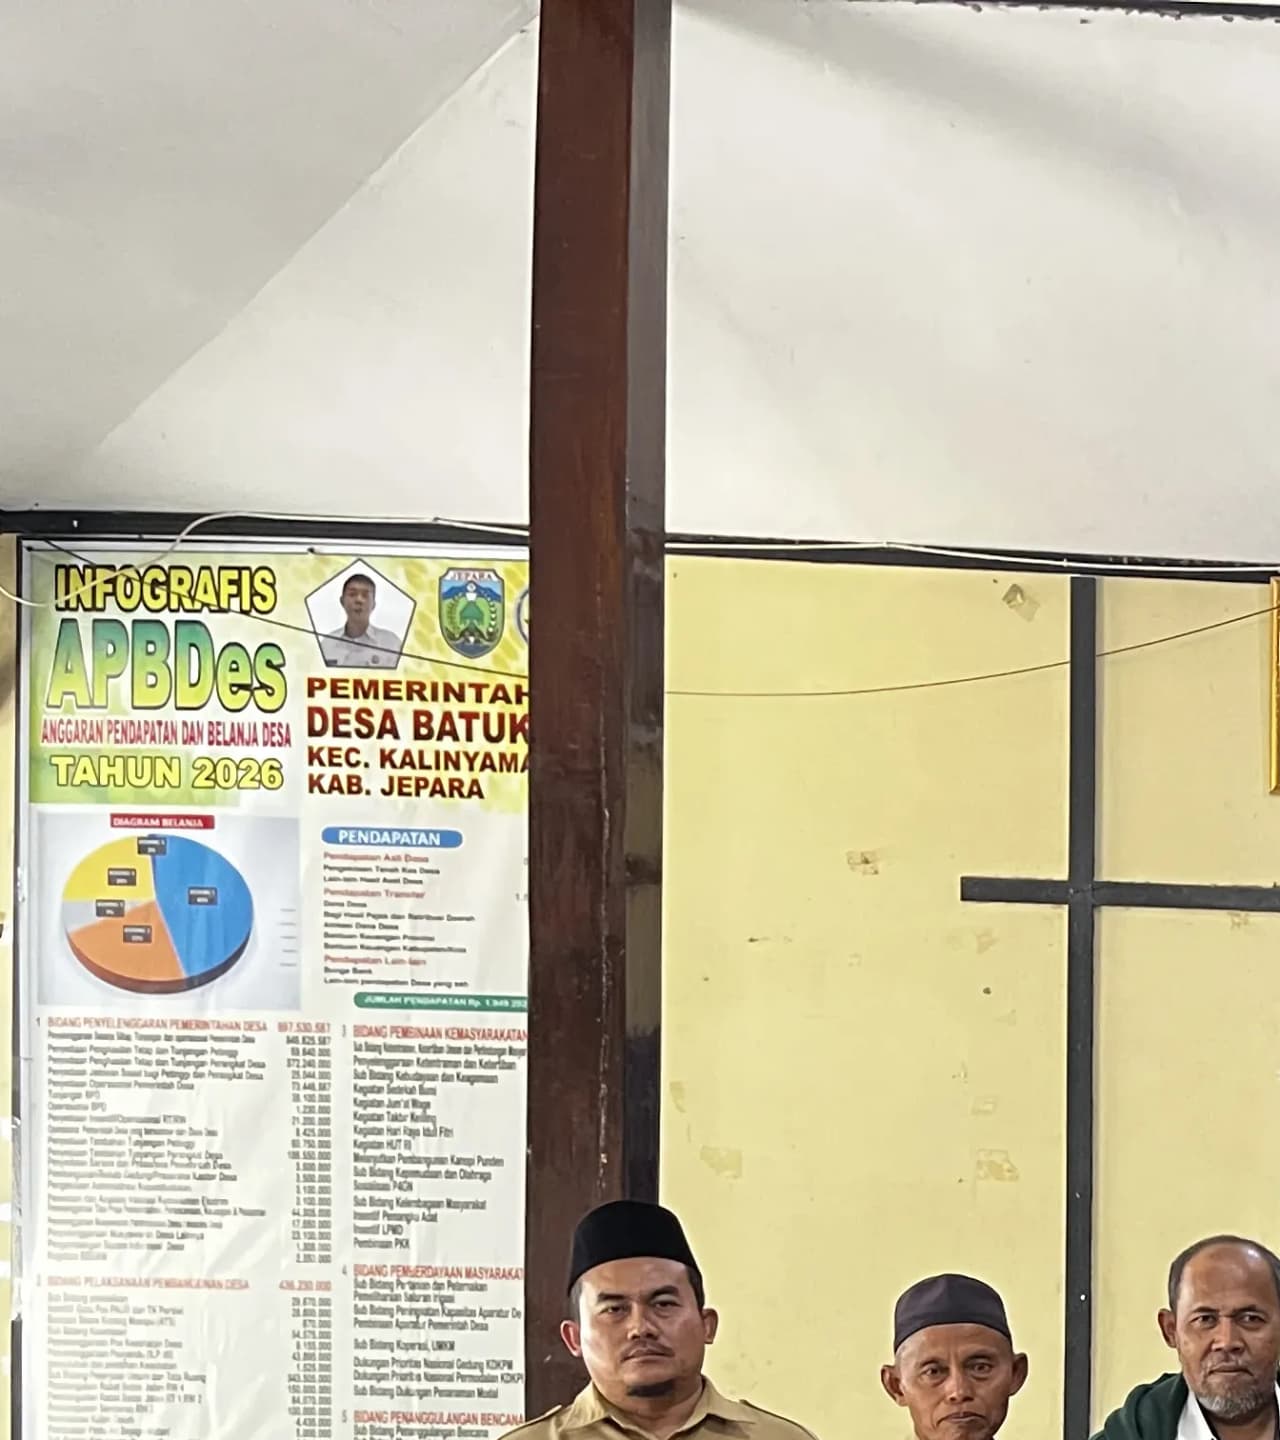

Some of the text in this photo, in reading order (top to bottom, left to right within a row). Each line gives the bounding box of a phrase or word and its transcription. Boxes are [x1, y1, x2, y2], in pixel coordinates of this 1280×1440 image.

[55, 564, 277, 614] INFOGRAFIS
[46, 618, 288, 713] APBDes
[307, 677, 529, 705] PEMERINTAH
[41, 718, 292, 747] ANGGARAN PENDAPATAN DAN BELANJA DESA
[307, 706, 401, 740] DESA
[307, 745, 370, 768] KEC.
[51, 755, 284, 790] TAHUN 2026
[308, 773, 485, 799] KAB. JEPARA
[112, 816, 161, 828] DIAGRAM
[338, 829, 441, 846] PENDAPATAN
